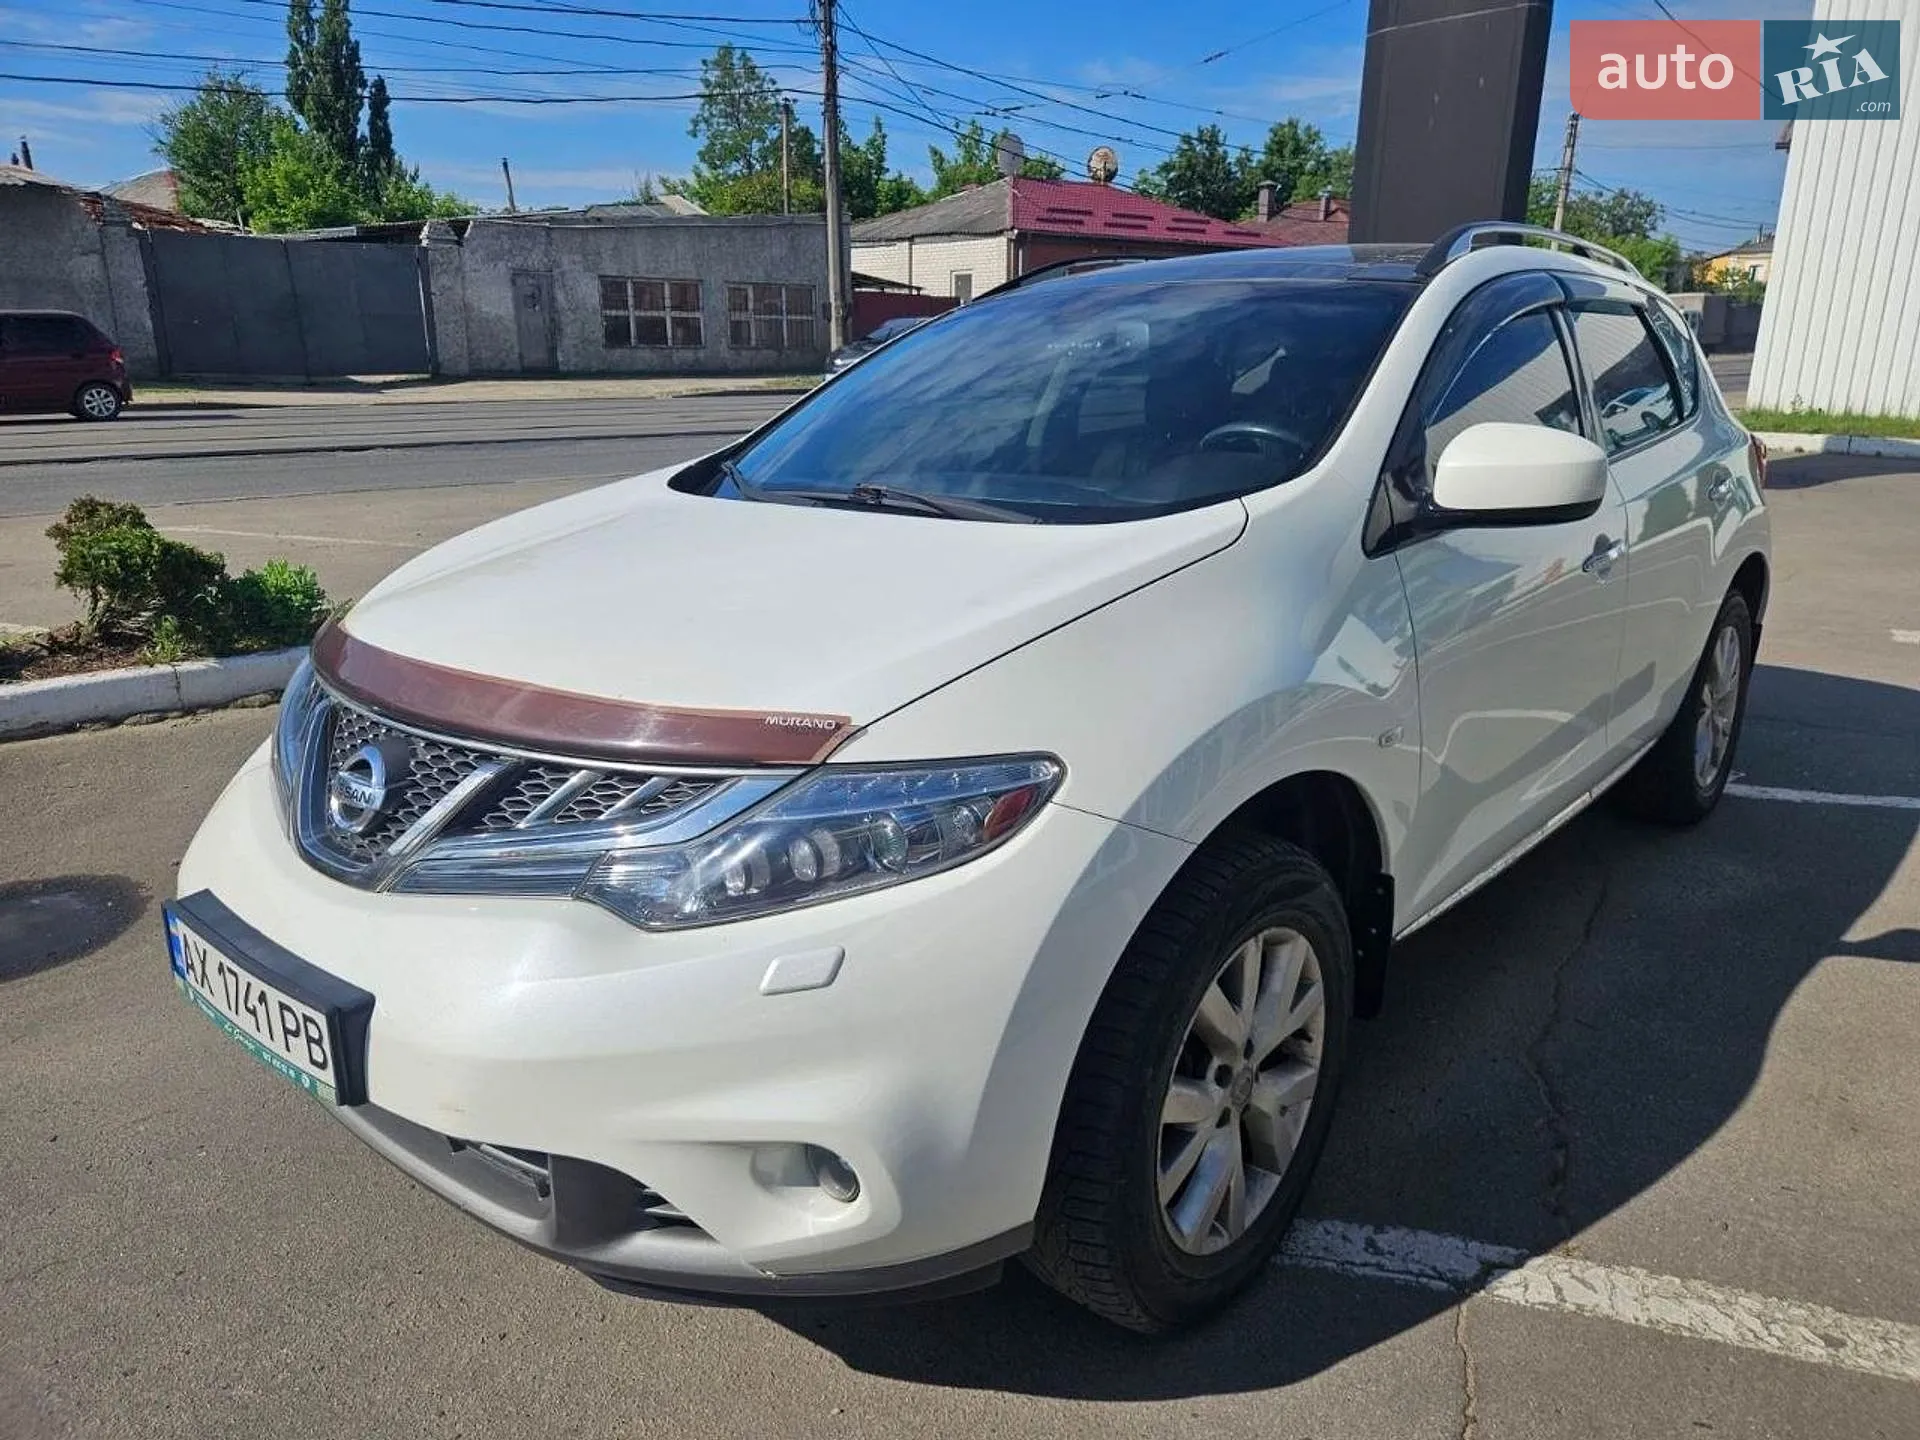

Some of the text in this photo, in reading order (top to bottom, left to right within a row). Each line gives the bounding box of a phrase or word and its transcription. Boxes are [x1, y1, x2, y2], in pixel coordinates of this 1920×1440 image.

[765, 716, 836, 730] MURANO
[183, 932, 214, 997] AX
[217, 960, 275, 1042] 1741
[278, 1000, 328, 1071] PB
